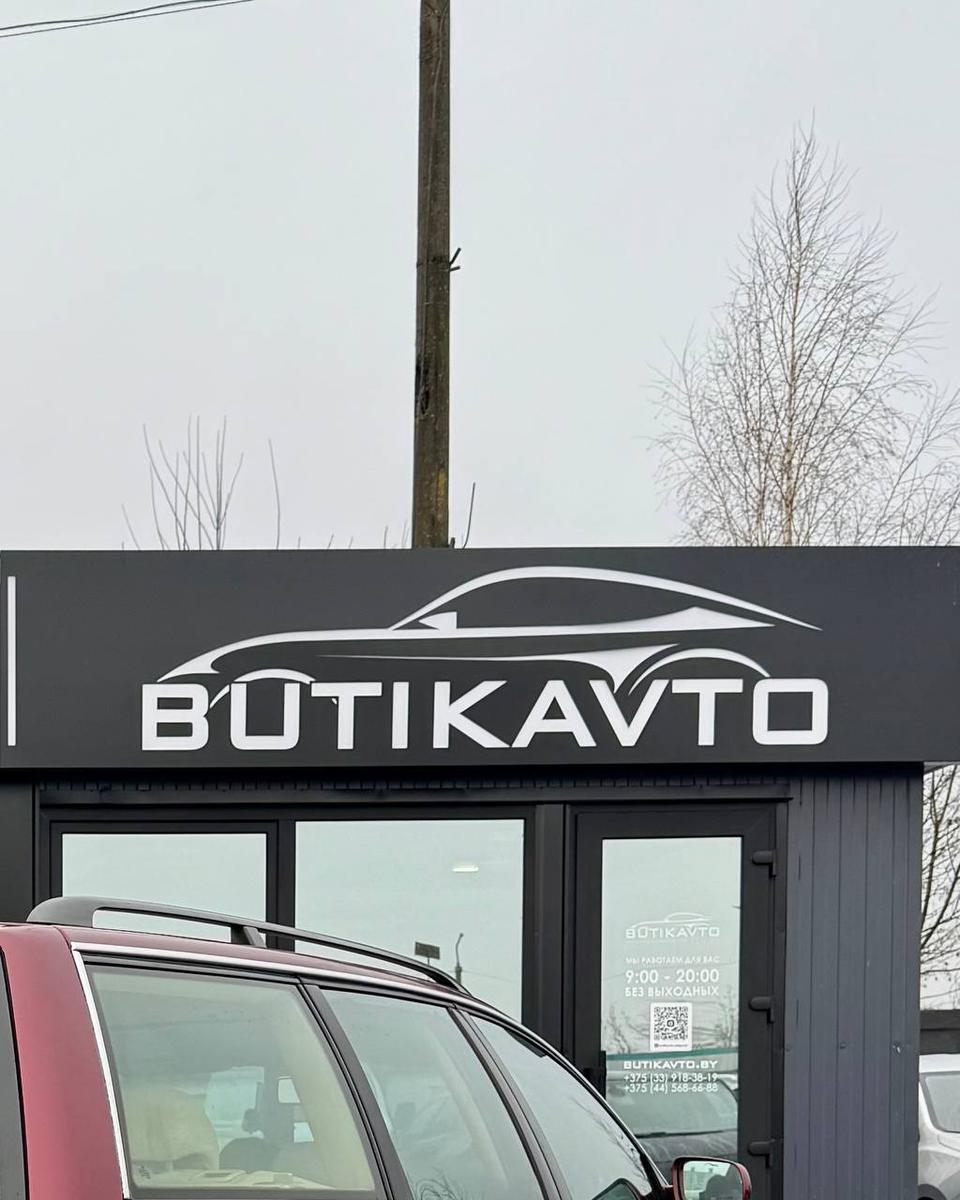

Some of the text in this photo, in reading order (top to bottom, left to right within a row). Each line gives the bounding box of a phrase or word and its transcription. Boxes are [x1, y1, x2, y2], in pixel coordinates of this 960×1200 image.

[142, 677, 828, 750] BUTIKAVTO
[625, 926, 720, 938] BUTIKAVTO
[625, 969, 658, 984] 9:00
[676, 968, 720, 983] 20:00
[625, 986, 720, 997] БЕЗ ВЫХОДНЫХ
[623, 1060, 718, 1070] BUTIKAVTO.BY
[624, 1072, 719, 1084] +375 (33) 918-38-19
[624, 1083, 719, 1094] +375 (44) 568-66-88
